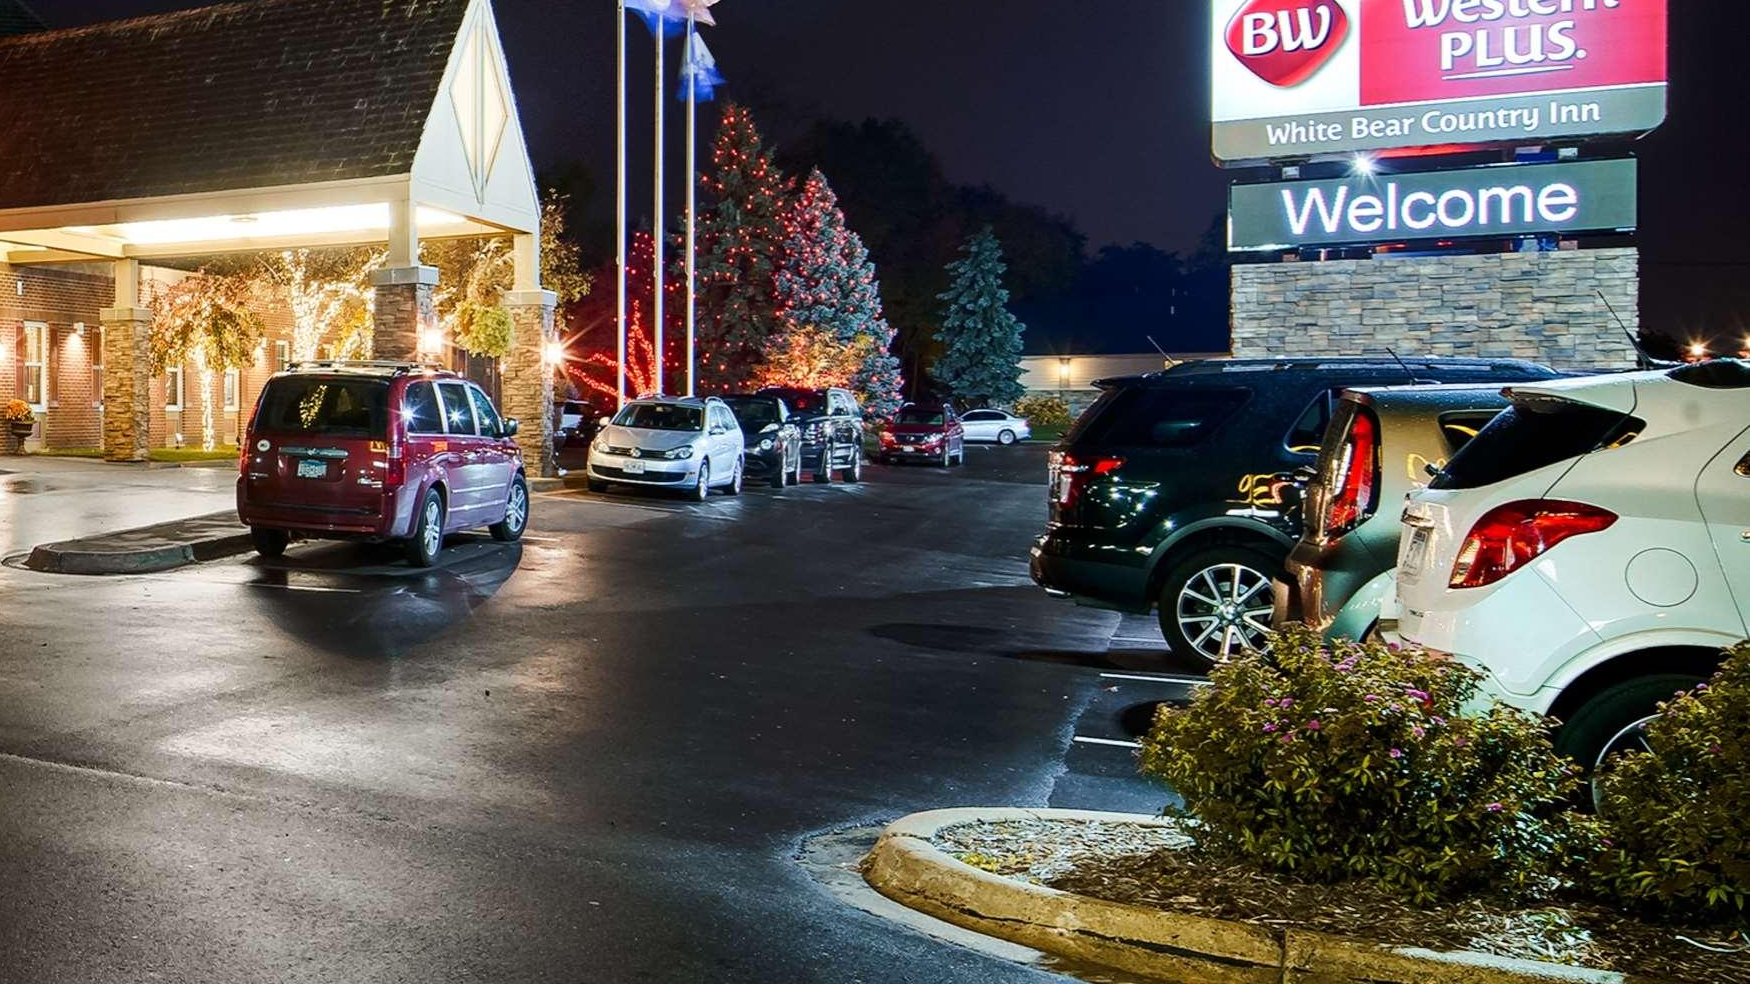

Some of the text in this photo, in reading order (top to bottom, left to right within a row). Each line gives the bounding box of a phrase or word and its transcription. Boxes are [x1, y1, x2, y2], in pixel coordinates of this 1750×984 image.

[1241, 4, 1333, 56] BW
[1265, 101, 1601, 146] White Bear Country Inn
[1281, 181, 1579, 235] Welcome
